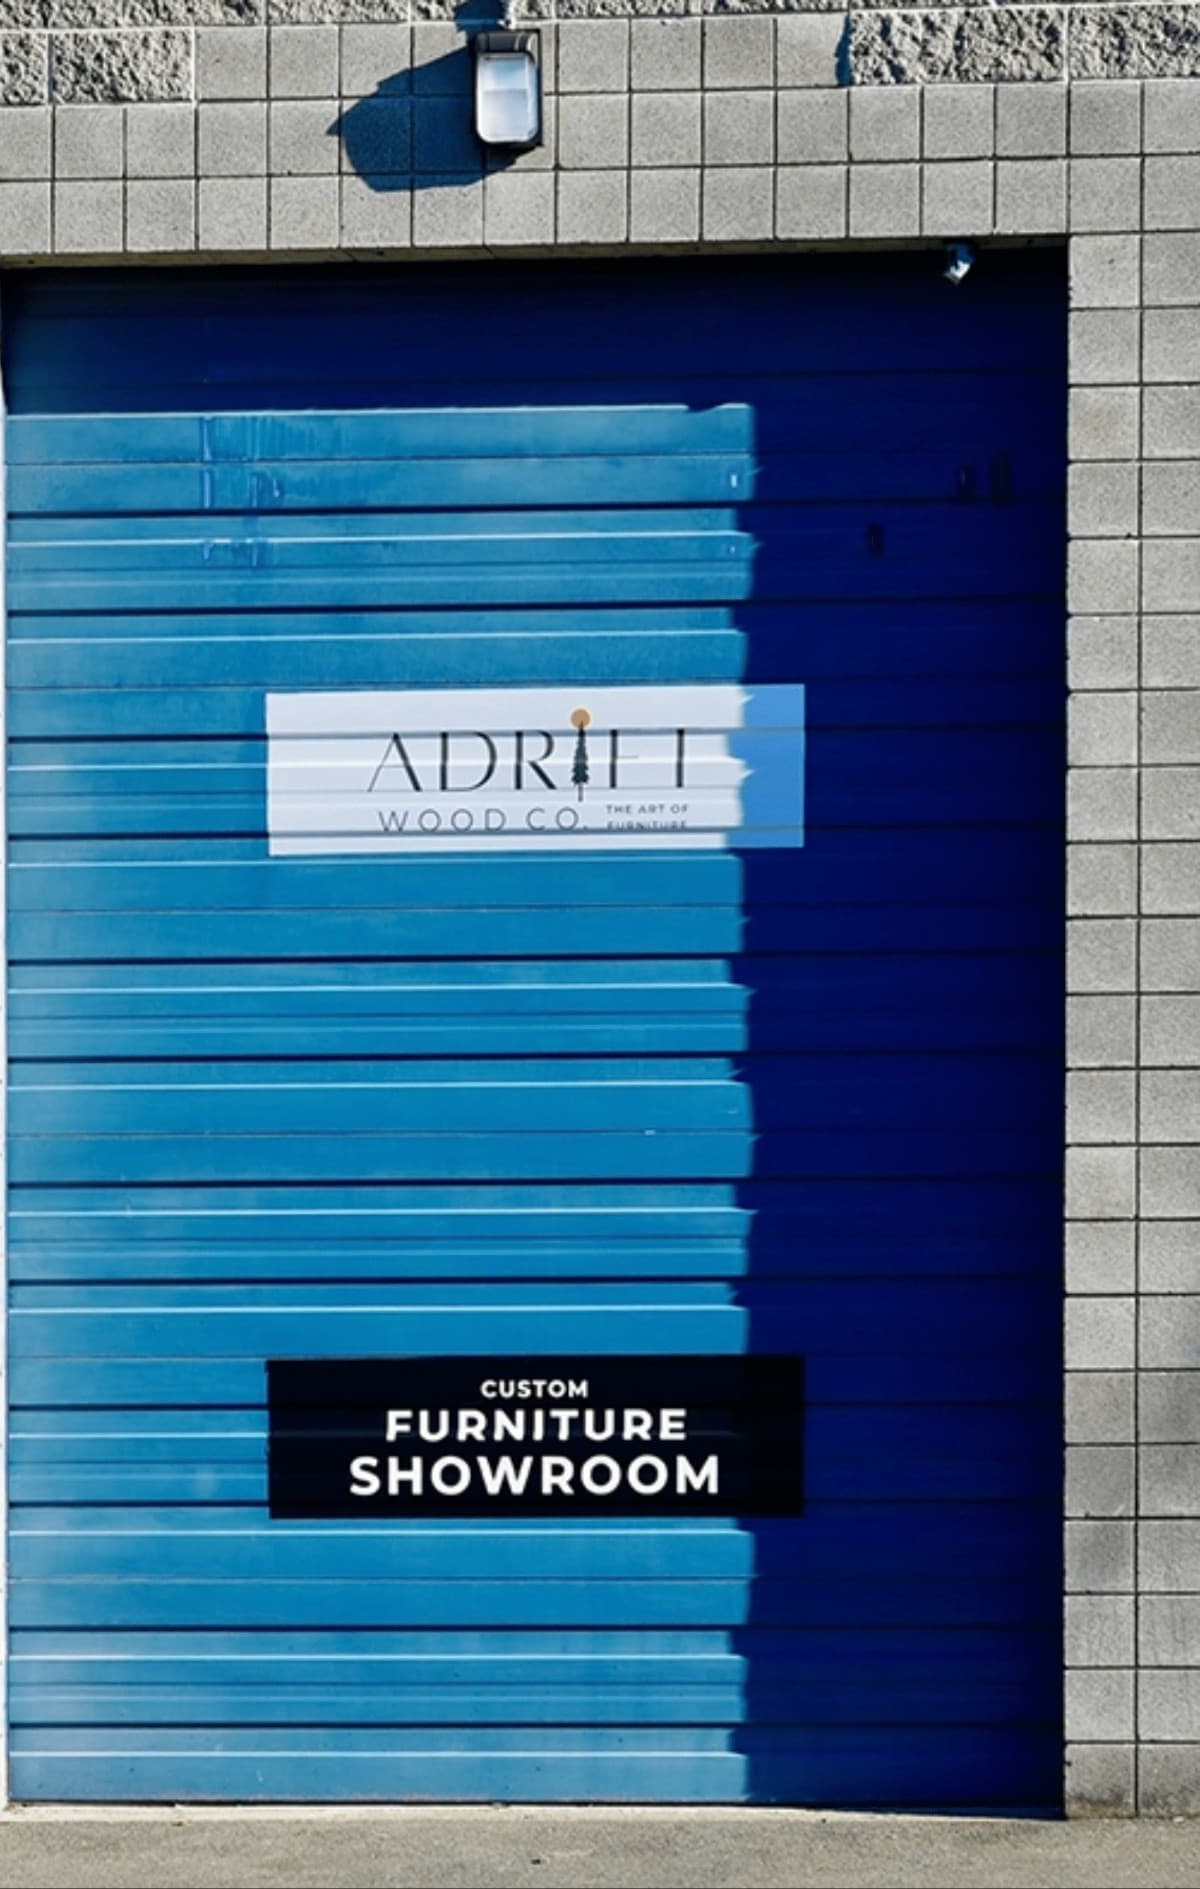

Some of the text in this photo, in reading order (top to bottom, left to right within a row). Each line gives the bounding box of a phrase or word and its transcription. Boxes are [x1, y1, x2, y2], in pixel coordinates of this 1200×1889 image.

[367, 709, 700, 802] ADRIFT
[378, 808, 506, 832] WOOD
[606, 803, 688, 815] THE ART OF
[479, 1379, 590, 1399] CUSTOM
[385, 1408, 688, 1442] FURNITURE
[348, 1454, 720, 1496] SHOWROOM
